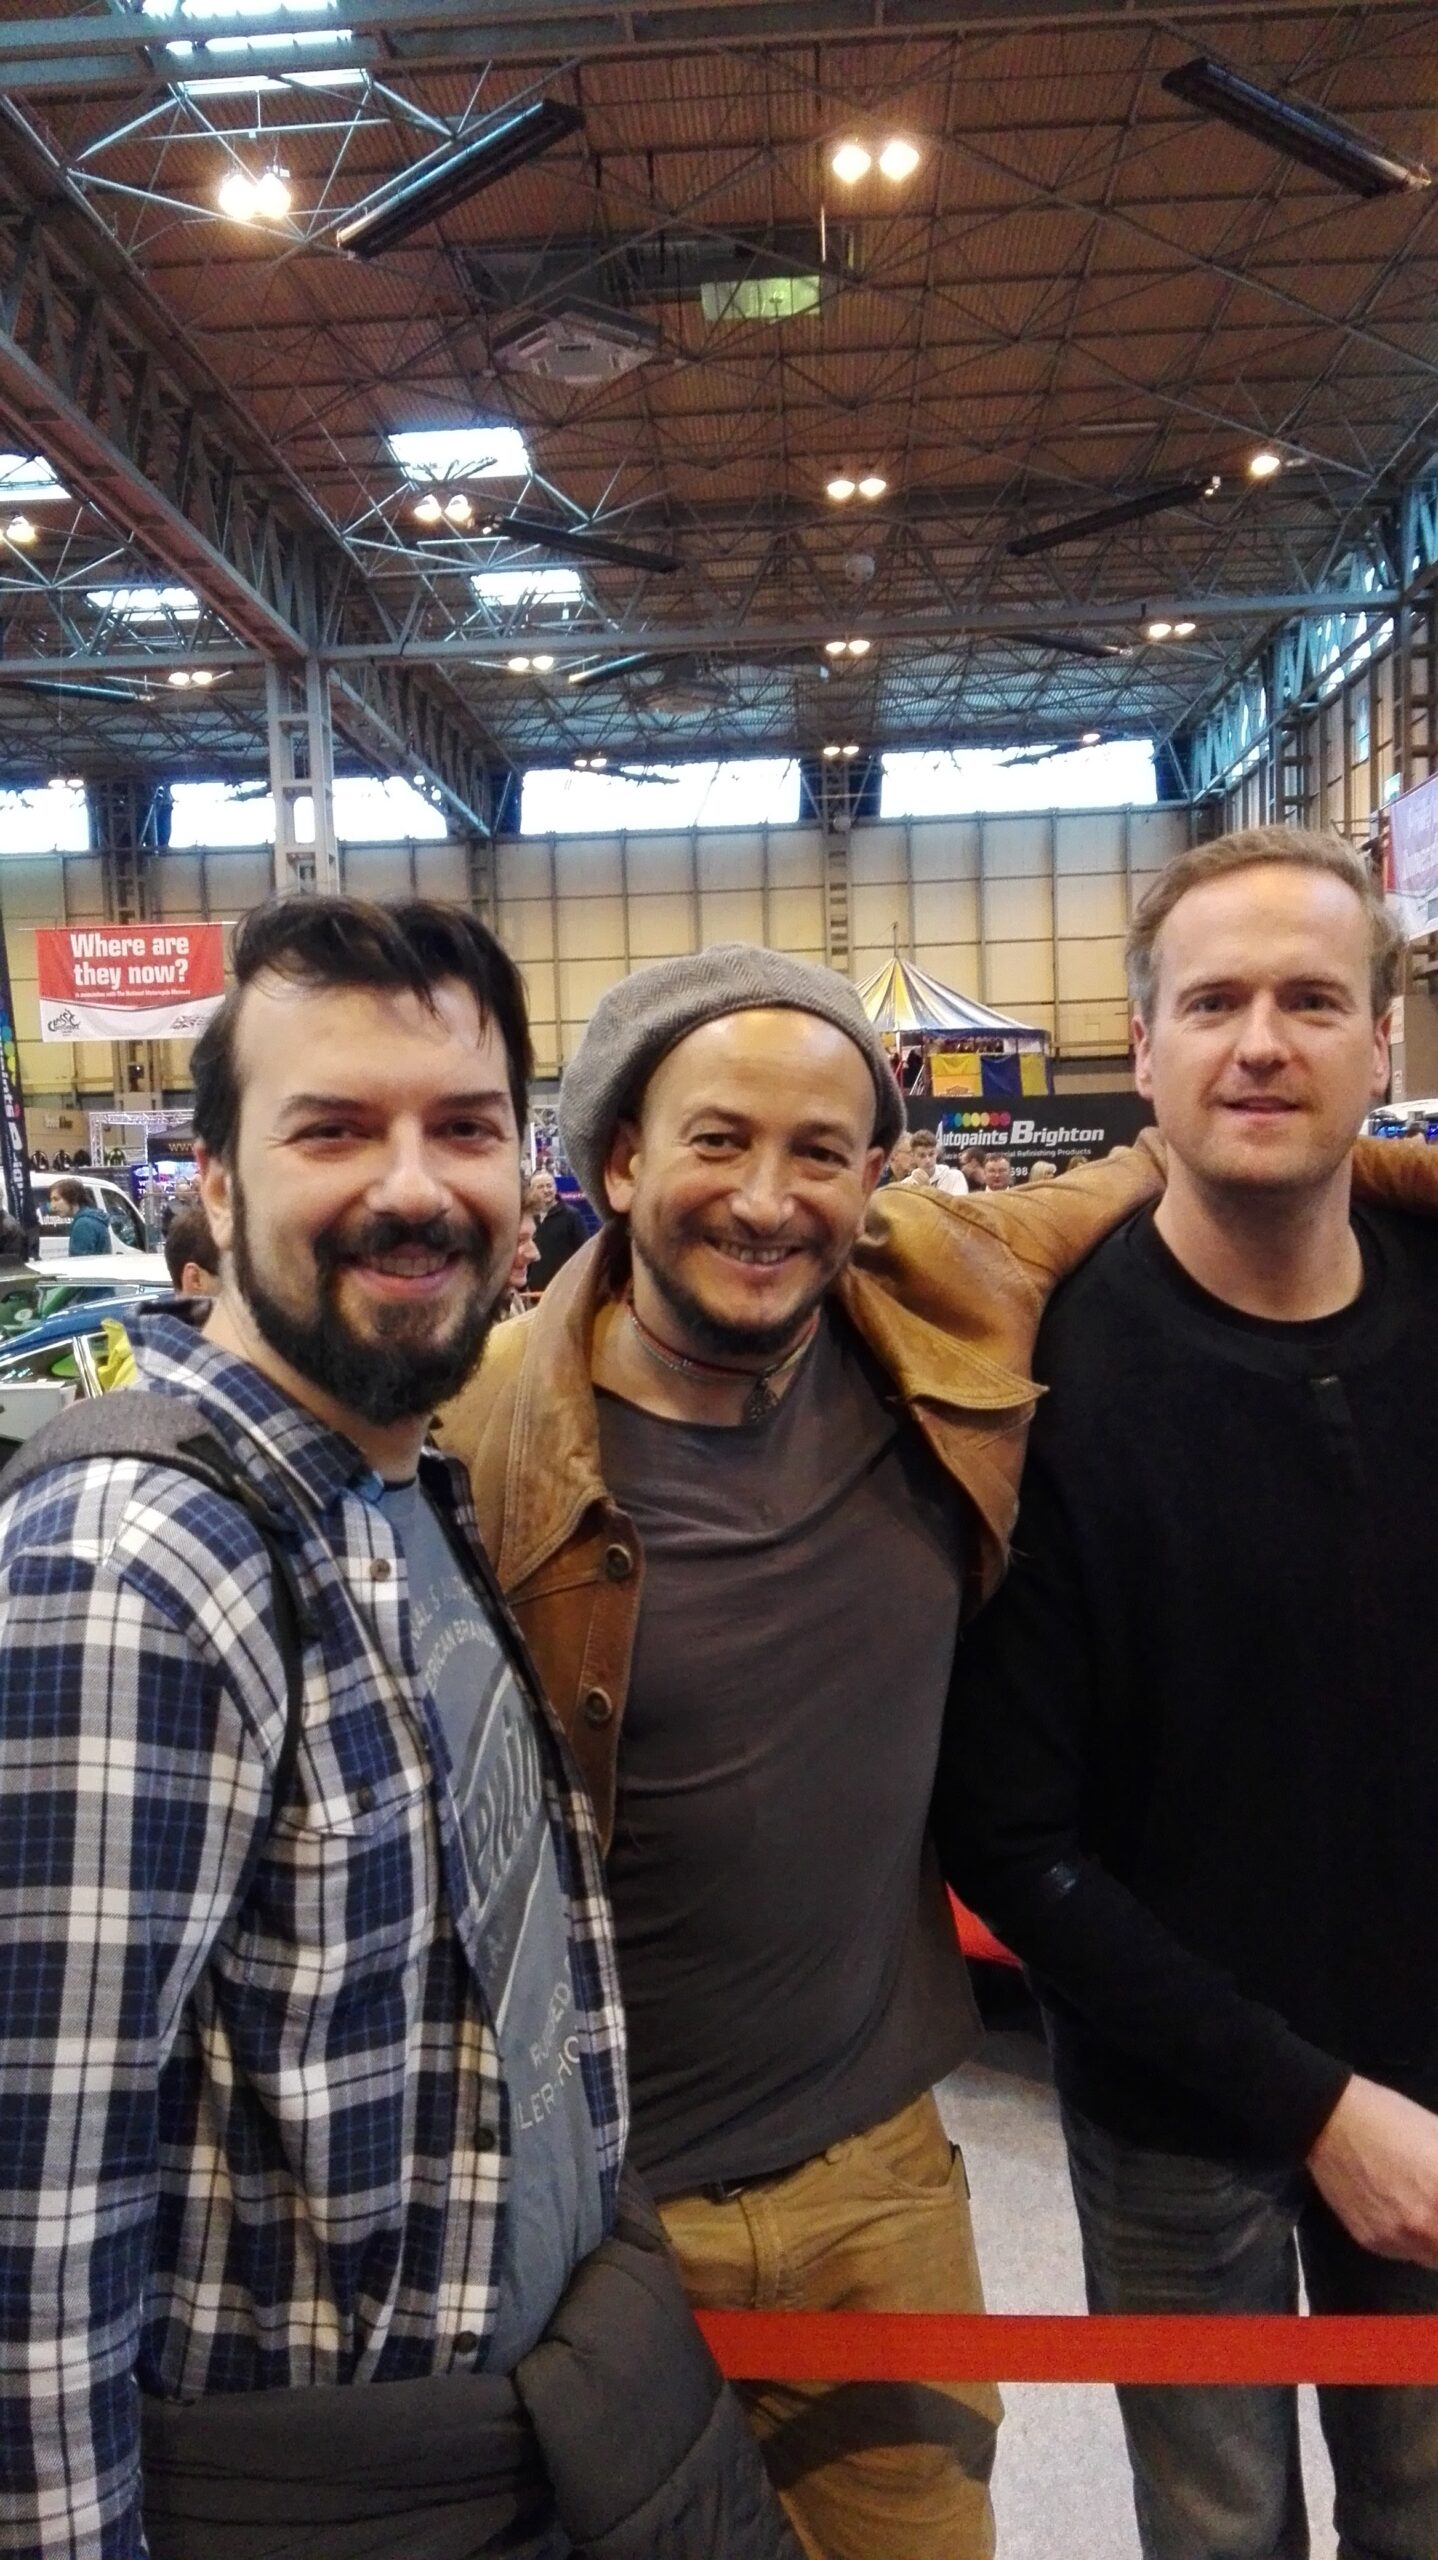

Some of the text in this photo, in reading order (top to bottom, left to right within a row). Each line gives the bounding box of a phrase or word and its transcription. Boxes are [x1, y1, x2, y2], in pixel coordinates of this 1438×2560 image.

[70, 932, 190, 958] Where are
[73, 958, 189, 990] they now?
[936, 1120, 1105, 1148] Autopaints Brighton
[1017, 1149, 1056, 1158] Refinishing
[1057, 1148, 1091, 1156] Products
